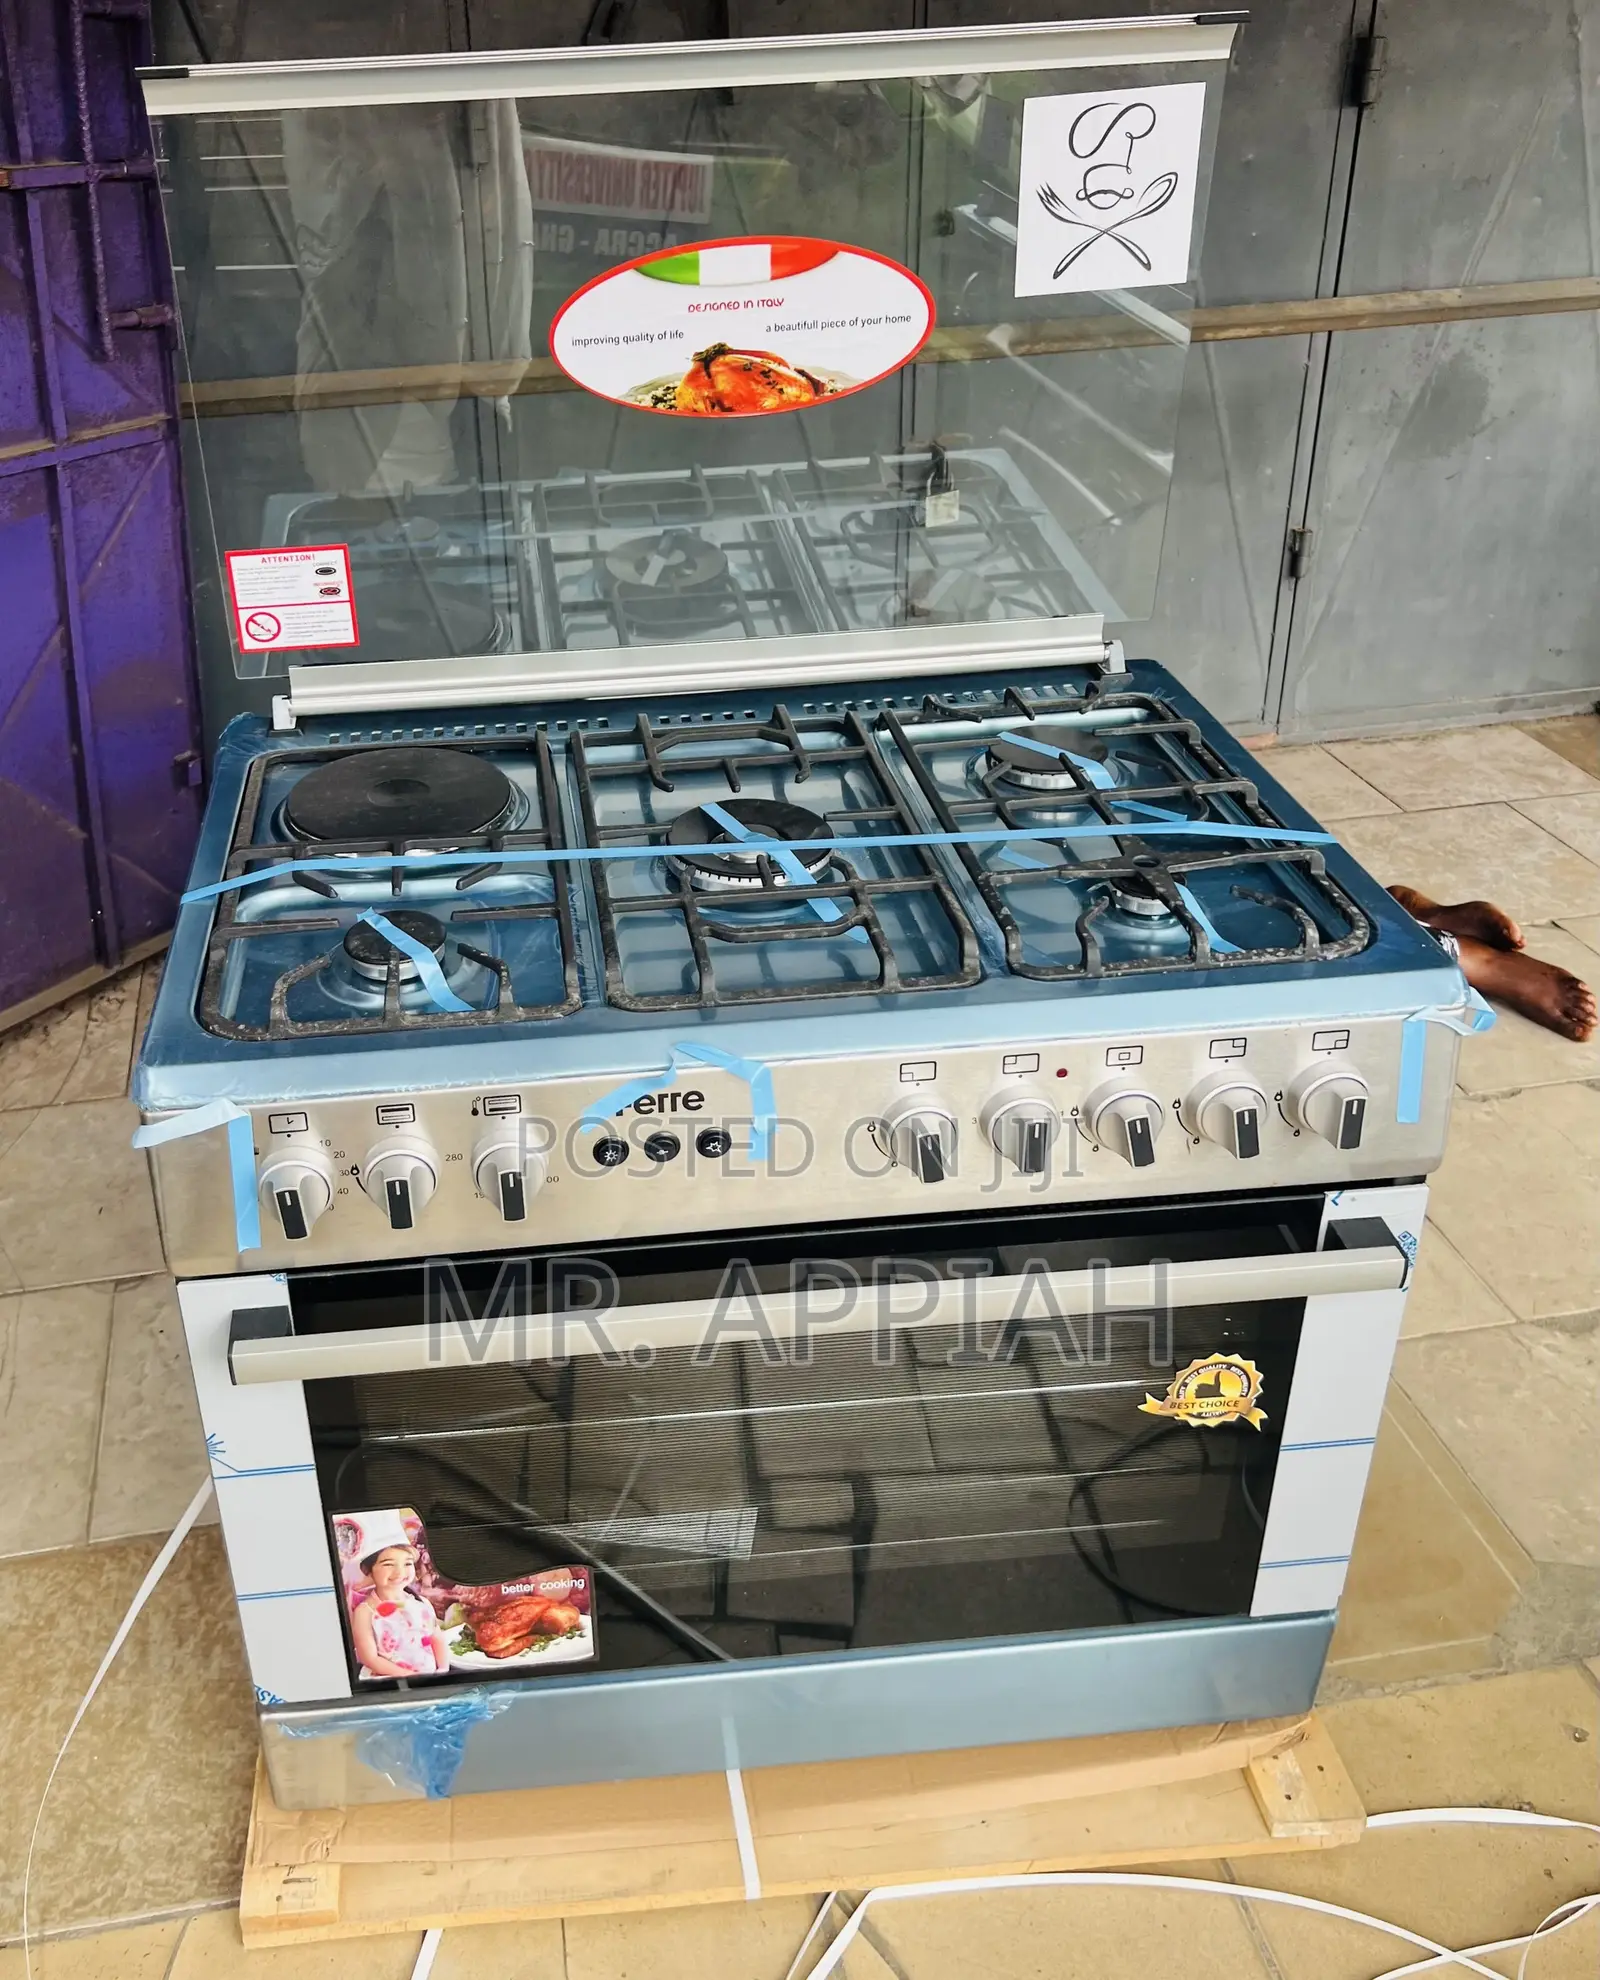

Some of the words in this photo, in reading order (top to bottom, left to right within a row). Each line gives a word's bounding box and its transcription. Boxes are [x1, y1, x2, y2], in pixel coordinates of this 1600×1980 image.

[688, 300, 740, 313] DESIGNED
[743, 300, 753, 309] IN
[757, 297, 785, 308] ITALY
[765, 324, 772, 333] a
[774, 320, 818, 333] beautifull
[821, 319, 846, 331] piece
[849, 317, 858, 327] of
[861, 316, 883, 328] your
[885, 314, 912, 325] home
[572, 334, 620, 348] improving
[622, 330, 655, 344] quality
[657, 330, 667, 341] of
[669, 329, 684, 340] life
[261, 553, 316, 564] ATTENTION!
[971, 1116, 978, 1125] 3
[319, 1139, 332, 1147] 10
[333, 1151, 346, 1159] 20
[445, 1153, 464, 1162] 280
[339, 1169, 350, 1177] 30
[337, 1187, 349, 1195] 40
[1199, 1400, 1240, 1409] CHOICE
[501, 1583, 535, 1594] better
[540, 1578, 585, 1589] cooking
